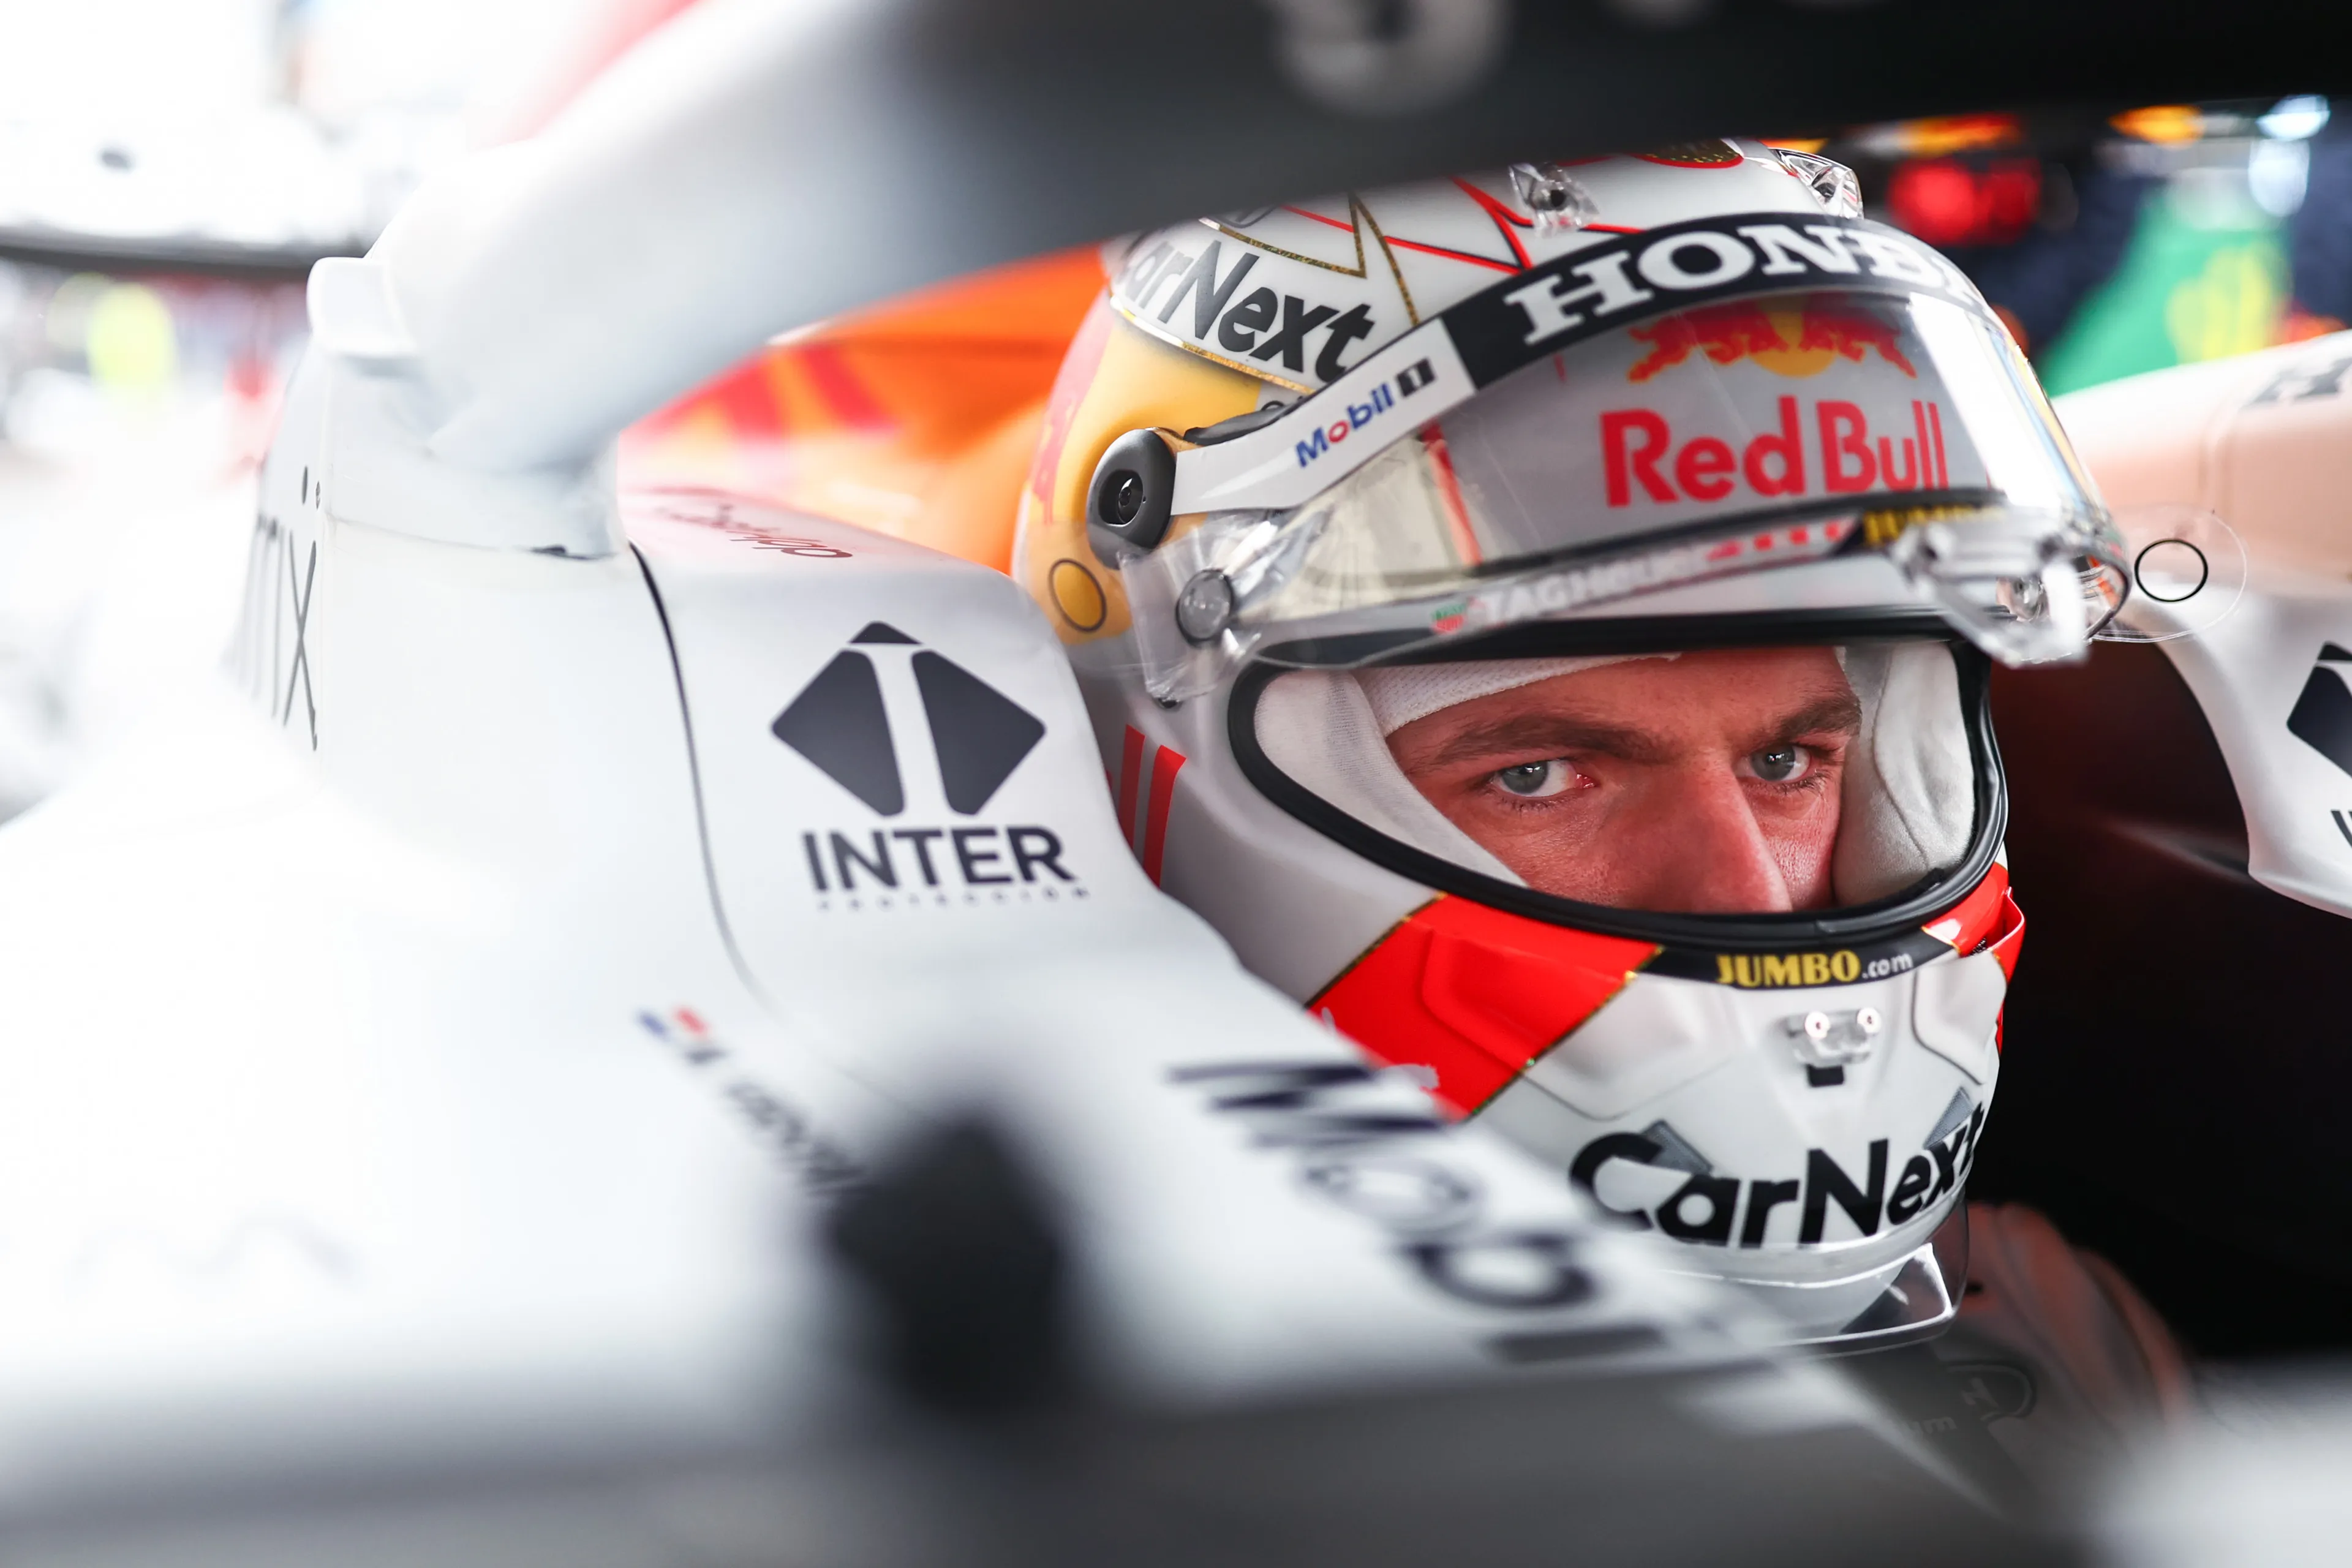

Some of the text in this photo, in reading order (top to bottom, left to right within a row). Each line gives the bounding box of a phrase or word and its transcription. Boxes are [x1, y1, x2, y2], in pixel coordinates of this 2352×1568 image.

[1116, 236, 1376, 384] arNext
[1295, 382, 1395, 468] Mobil
[1599, 395, 1949, 508] Red Bull
[802, 824, 1077, 892] INTER
[1569, 1101, 1985, 1250] CarNext
